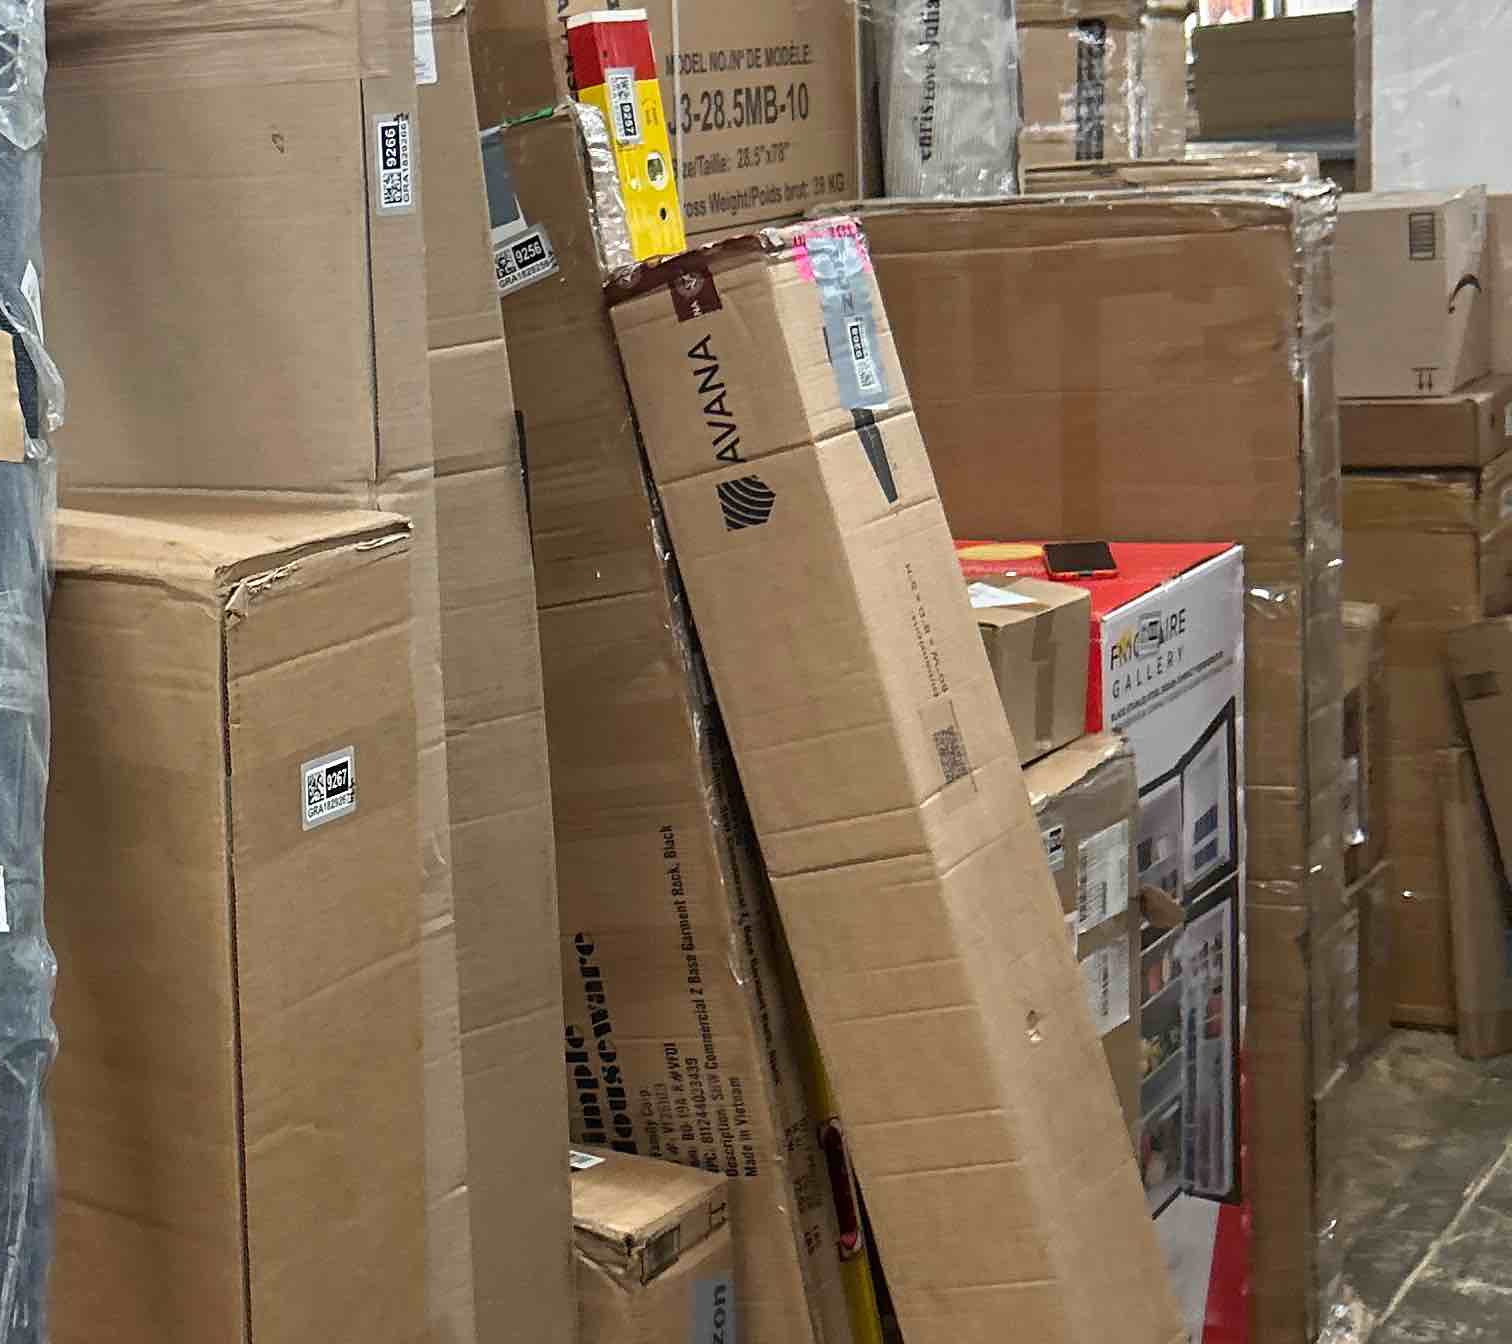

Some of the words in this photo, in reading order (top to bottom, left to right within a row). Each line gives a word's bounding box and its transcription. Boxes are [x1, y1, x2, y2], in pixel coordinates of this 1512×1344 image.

[385, 127, 397, 168] 9266
[516, 236, 543, 265] 9256
[688, 334, 745, 463] AVANA
[1112, 645, 1185, 699] GALLERY
[326, 766, 349, 793] 9267
[660, 824, 678, 859] Black
[674, 900, 696, 951] Garment
[687, 955, 701, 984] Base
[695, 999, 720, 1070] Commercial
[730, 1077, 747, 1126] Vietnam
[741, 1143, 759, 1177] Made
